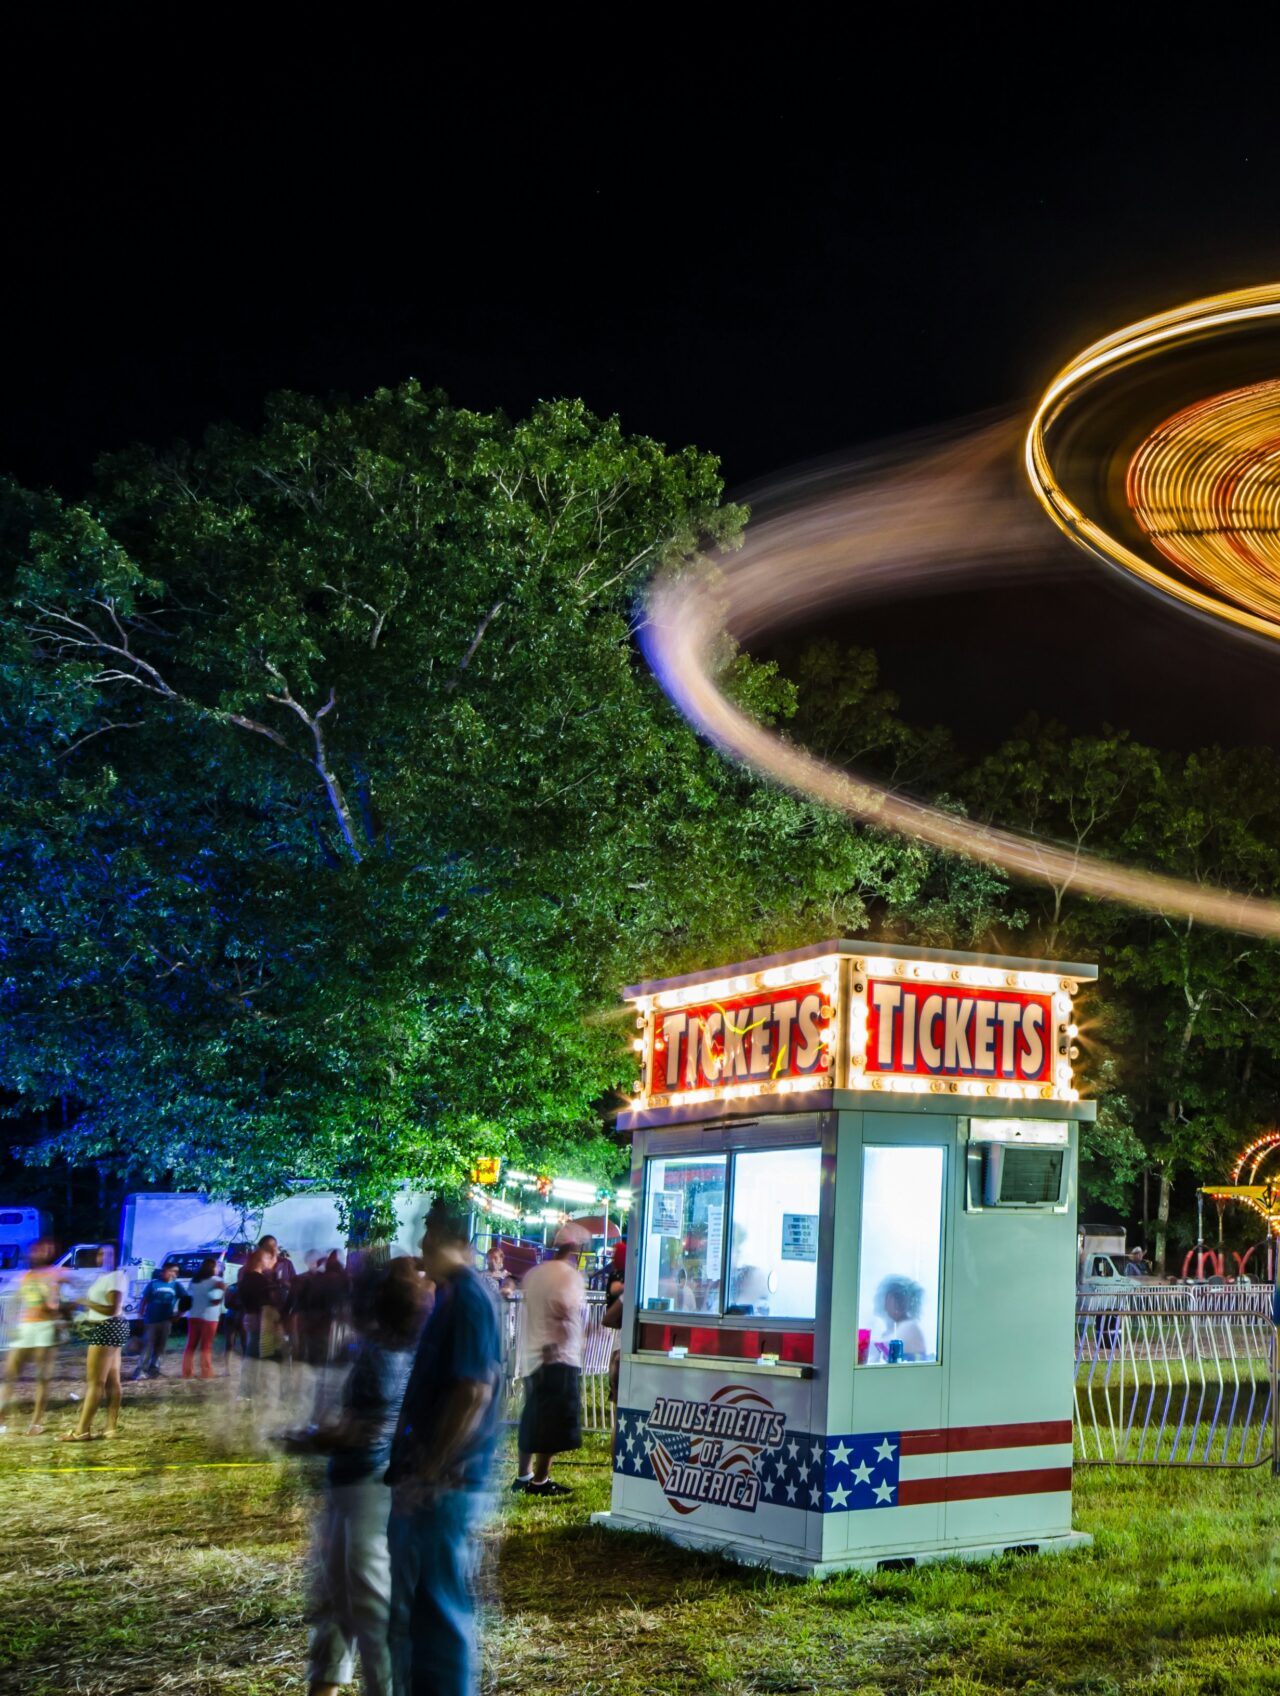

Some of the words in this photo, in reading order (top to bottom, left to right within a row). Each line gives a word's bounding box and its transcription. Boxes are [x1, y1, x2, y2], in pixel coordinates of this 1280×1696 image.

[663, 993, 821, 1088] TICKETS
[872, 982, 1045, 1078] TICKETS
[647, 1398, 785, 1444] AMUSEMENTS
[700, 1441, 722, 1465] OF
[664, 1465, 759, 1509] AMERICA
